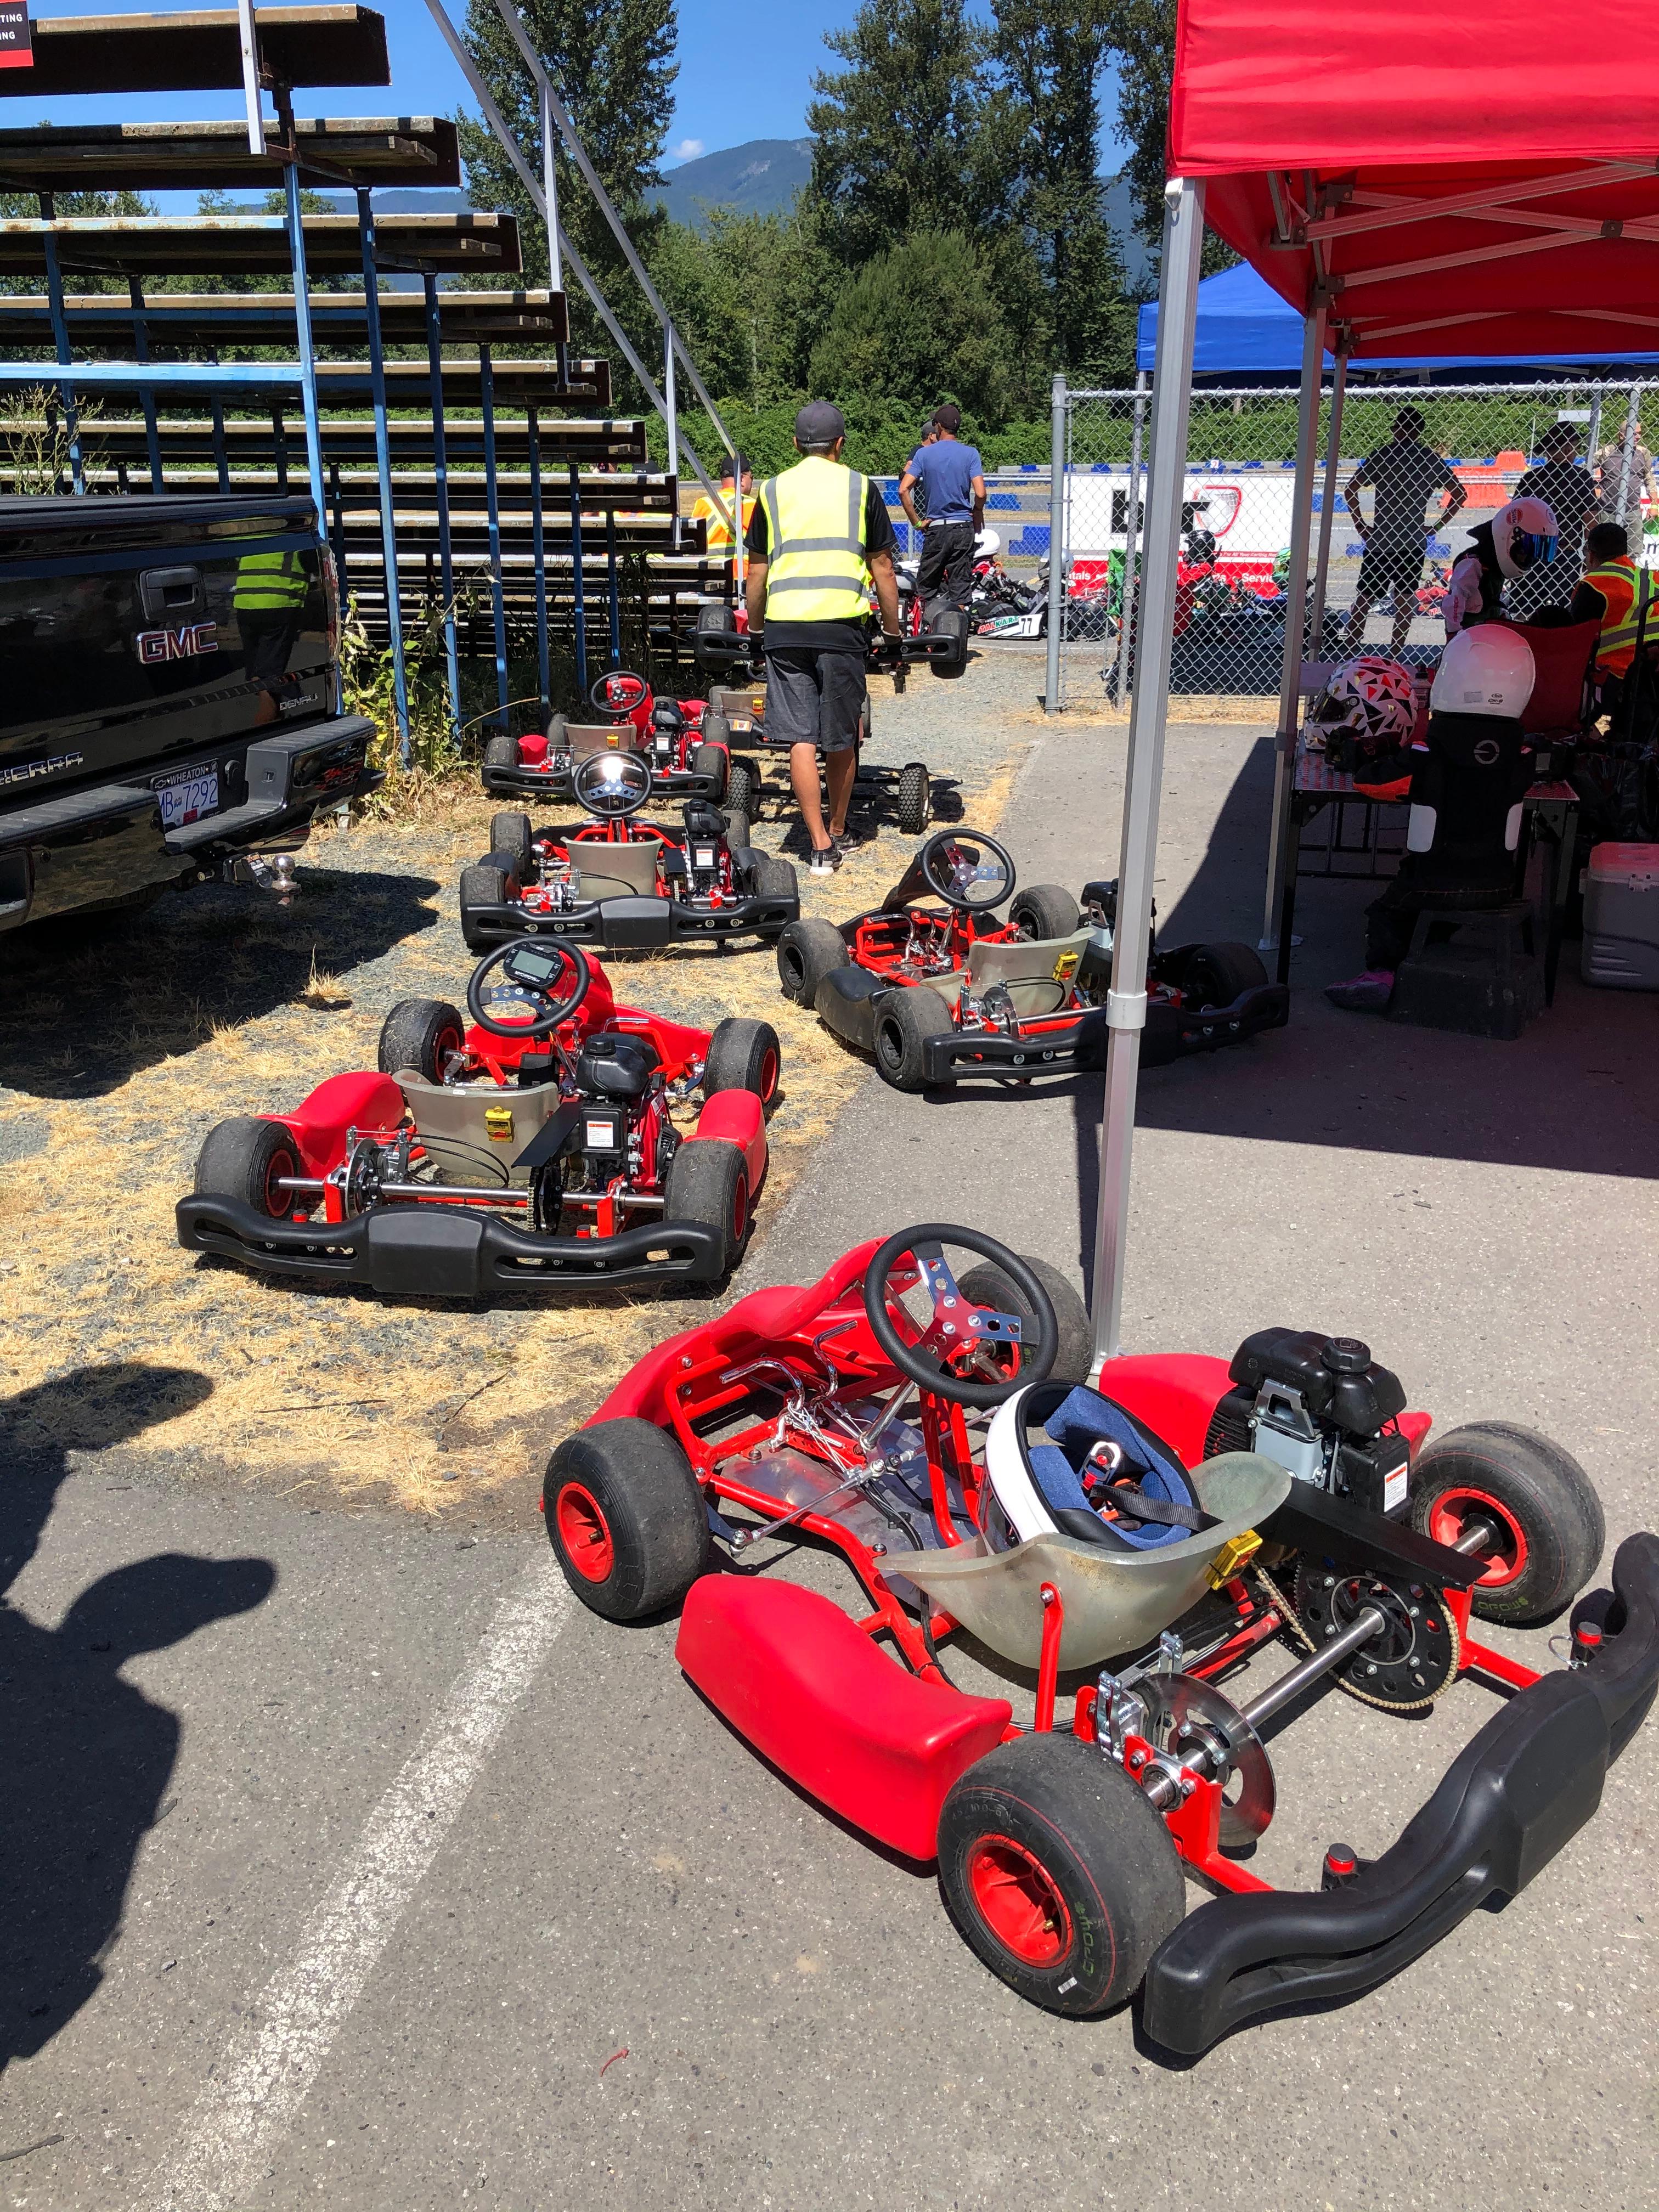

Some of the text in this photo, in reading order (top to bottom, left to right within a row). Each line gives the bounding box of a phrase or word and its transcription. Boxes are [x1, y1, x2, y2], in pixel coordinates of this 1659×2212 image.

[136, 621, 218, 664] GMC
[1021, 618, 1032, 634] 77
[0, 752, 83, 786] IERRA
[169, 765, 206, 785] WHEATON
[183, 778, 218, 811] 7292
